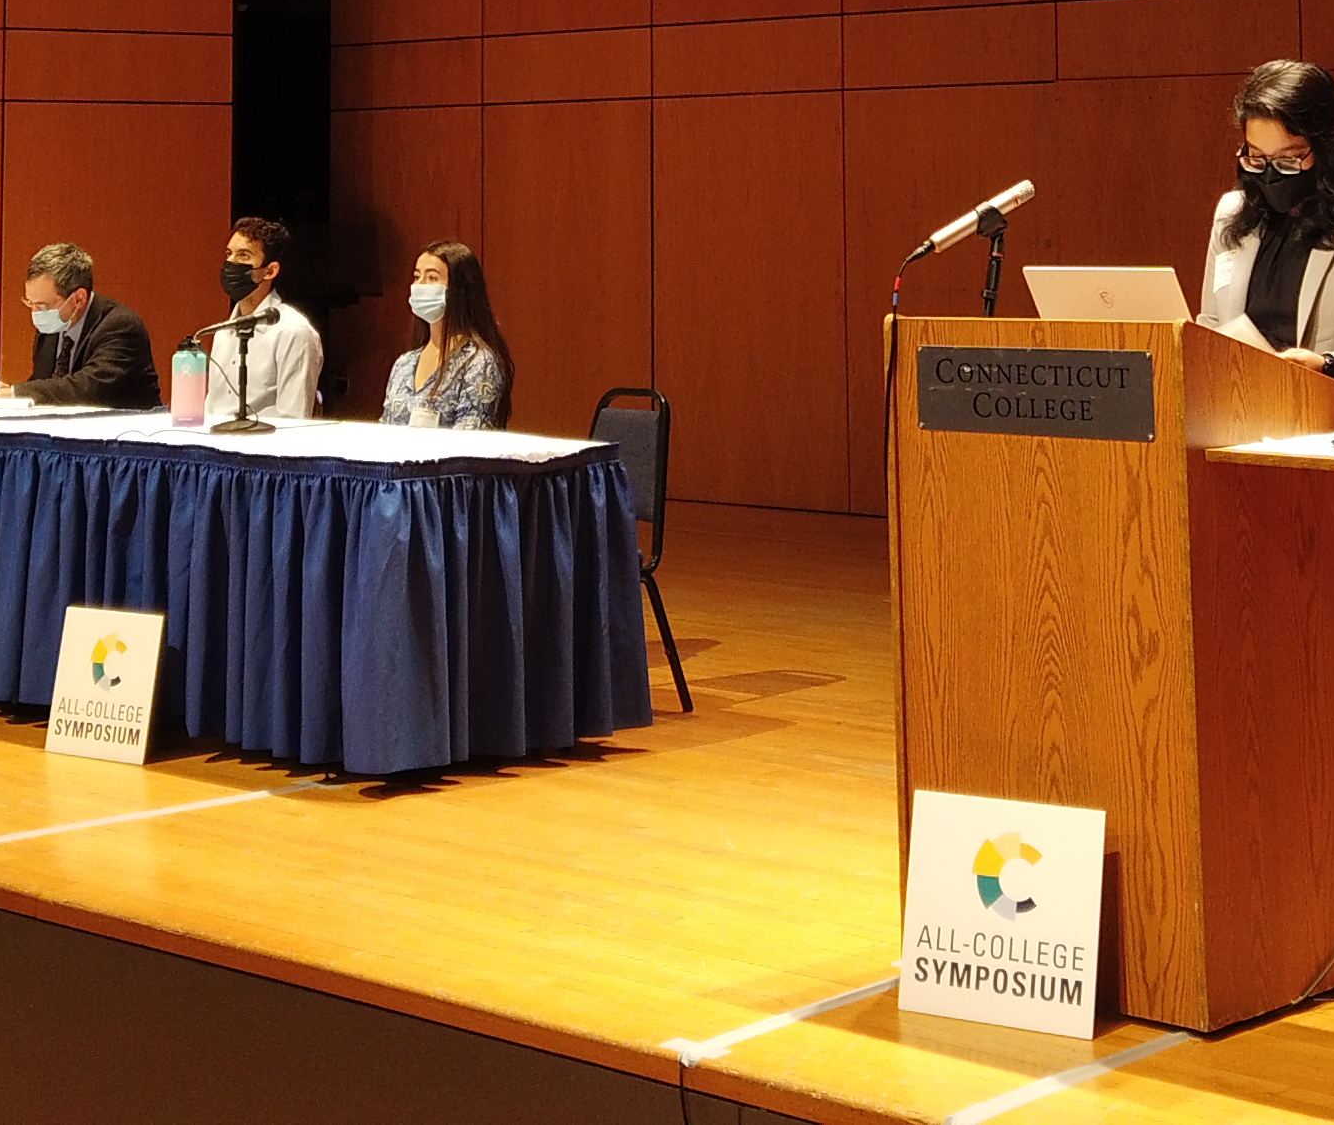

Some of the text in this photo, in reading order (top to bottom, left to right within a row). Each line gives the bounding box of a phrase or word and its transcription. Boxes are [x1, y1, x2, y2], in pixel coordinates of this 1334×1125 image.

[57, 697, 144, 724] ALL-COLLEGE
[54, 718, 141, 746] SYMPOSIUM
[916, 924, 1085, 972] ALL-COLLEGE
[913, 956, 1083, 1007] SYMPOSIUM
